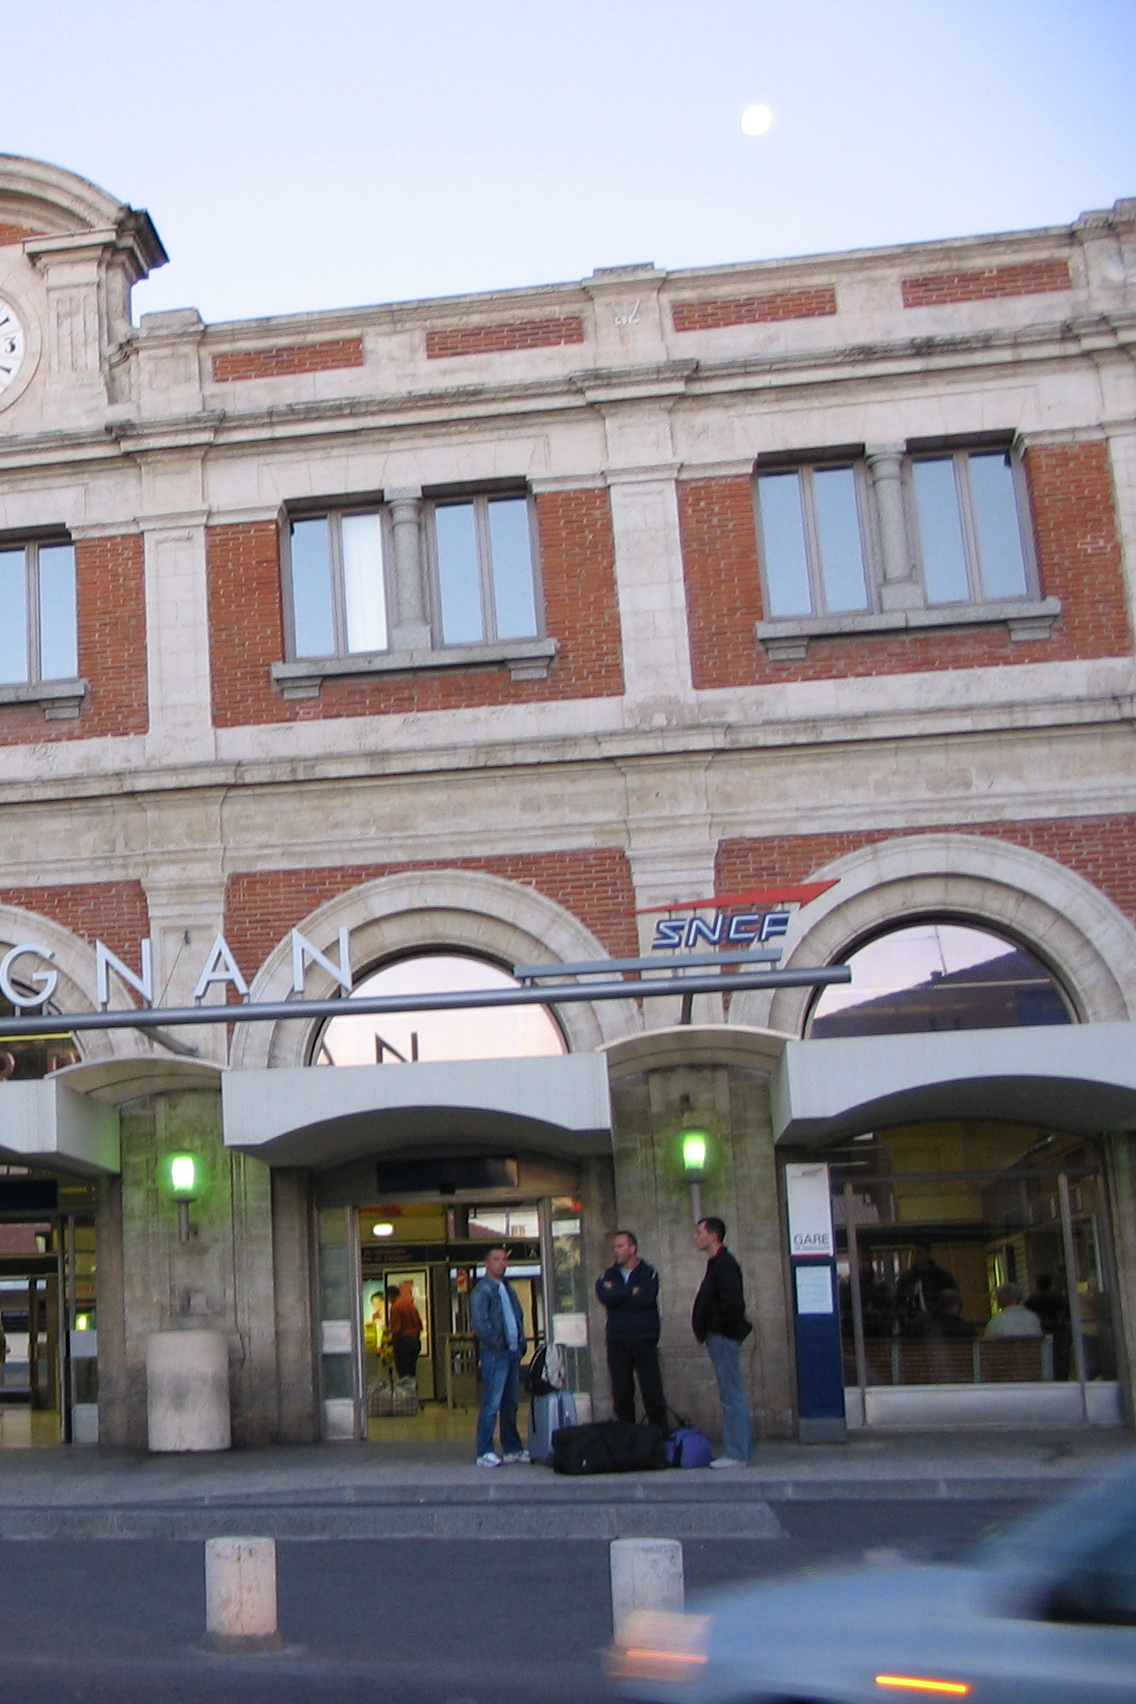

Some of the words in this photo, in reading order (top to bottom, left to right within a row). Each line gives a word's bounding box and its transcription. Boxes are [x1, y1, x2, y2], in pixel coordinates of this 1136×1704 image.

[4, 336, 17, 353] 3
[651, 910, 791, 950] SNCF
[793, 1233, 830, 1246] GARE
